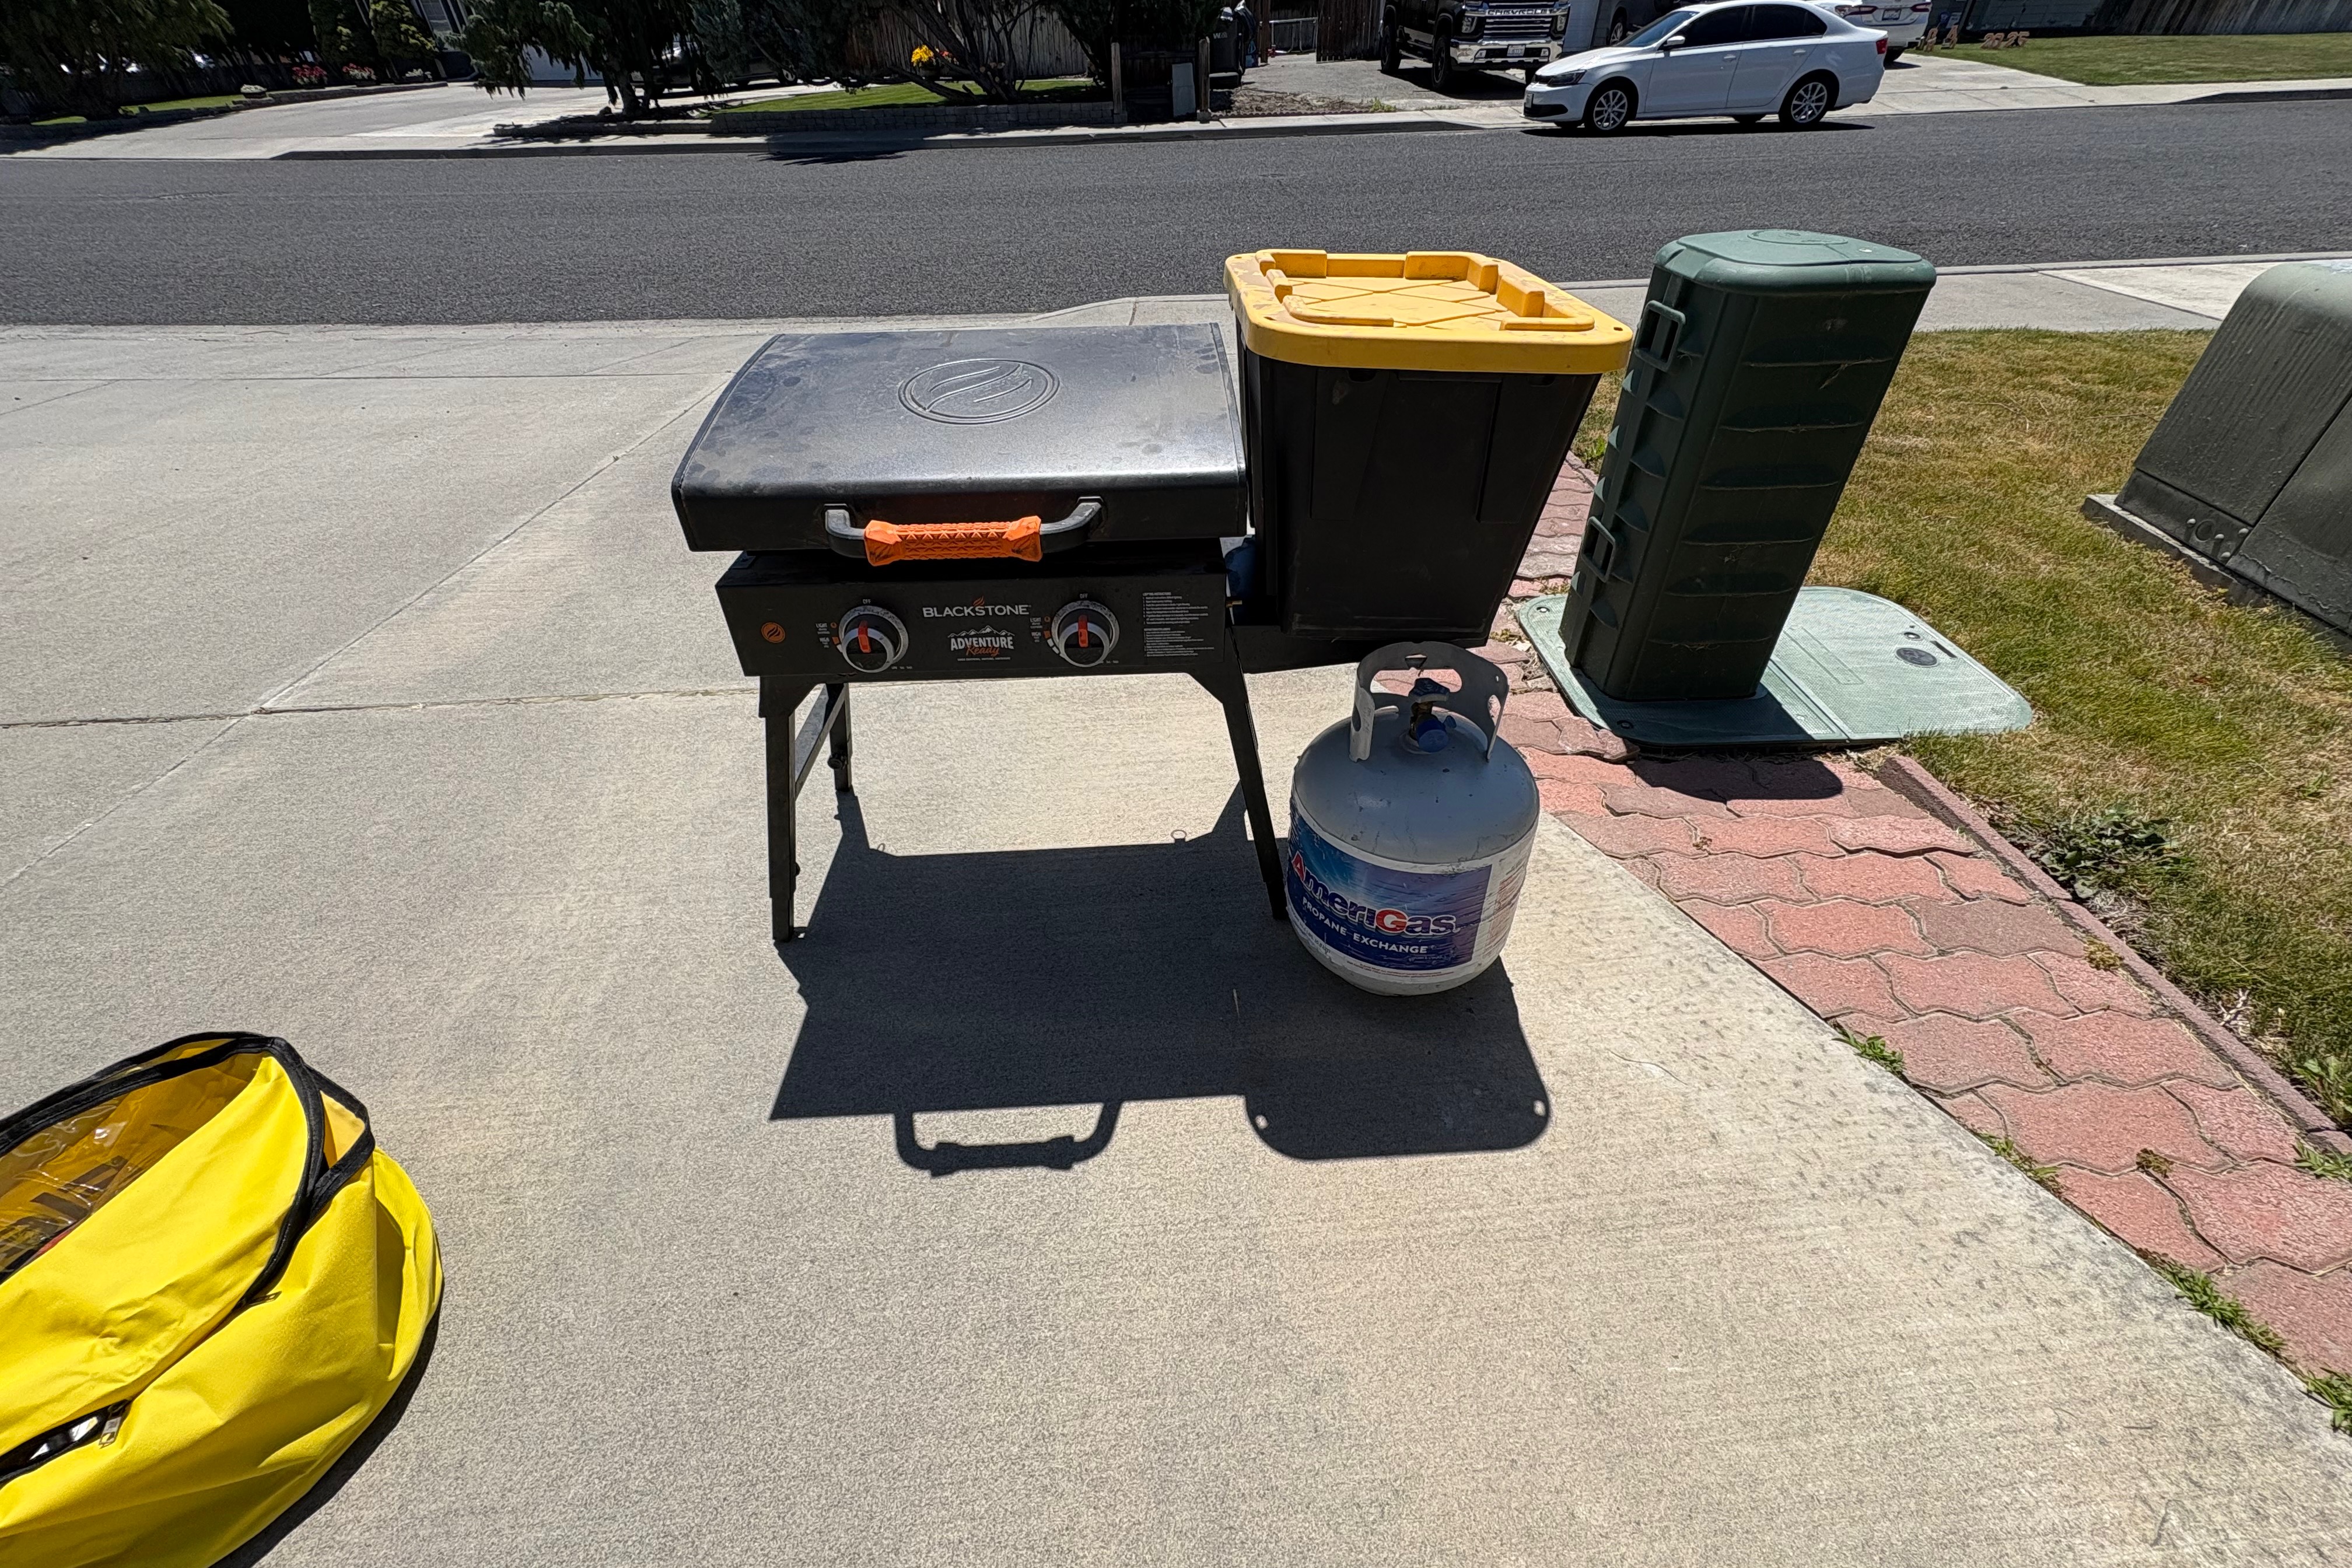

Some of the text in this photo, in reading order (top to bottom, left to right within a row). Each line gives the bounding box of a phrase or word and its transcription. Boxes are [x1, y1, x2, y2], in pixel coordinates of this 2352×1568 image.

[922, 604, 1030, 618] BLACKSTONE
[950, 636, 1014, 652] ADVENTURE
[965, 644, 999, 657] Ready
[1291, 850, 1457, 936] AmeriGas
[1302, 896, 1347, 936] PROPANE
[1352, 933, 1429, 954] EXCHANGE
